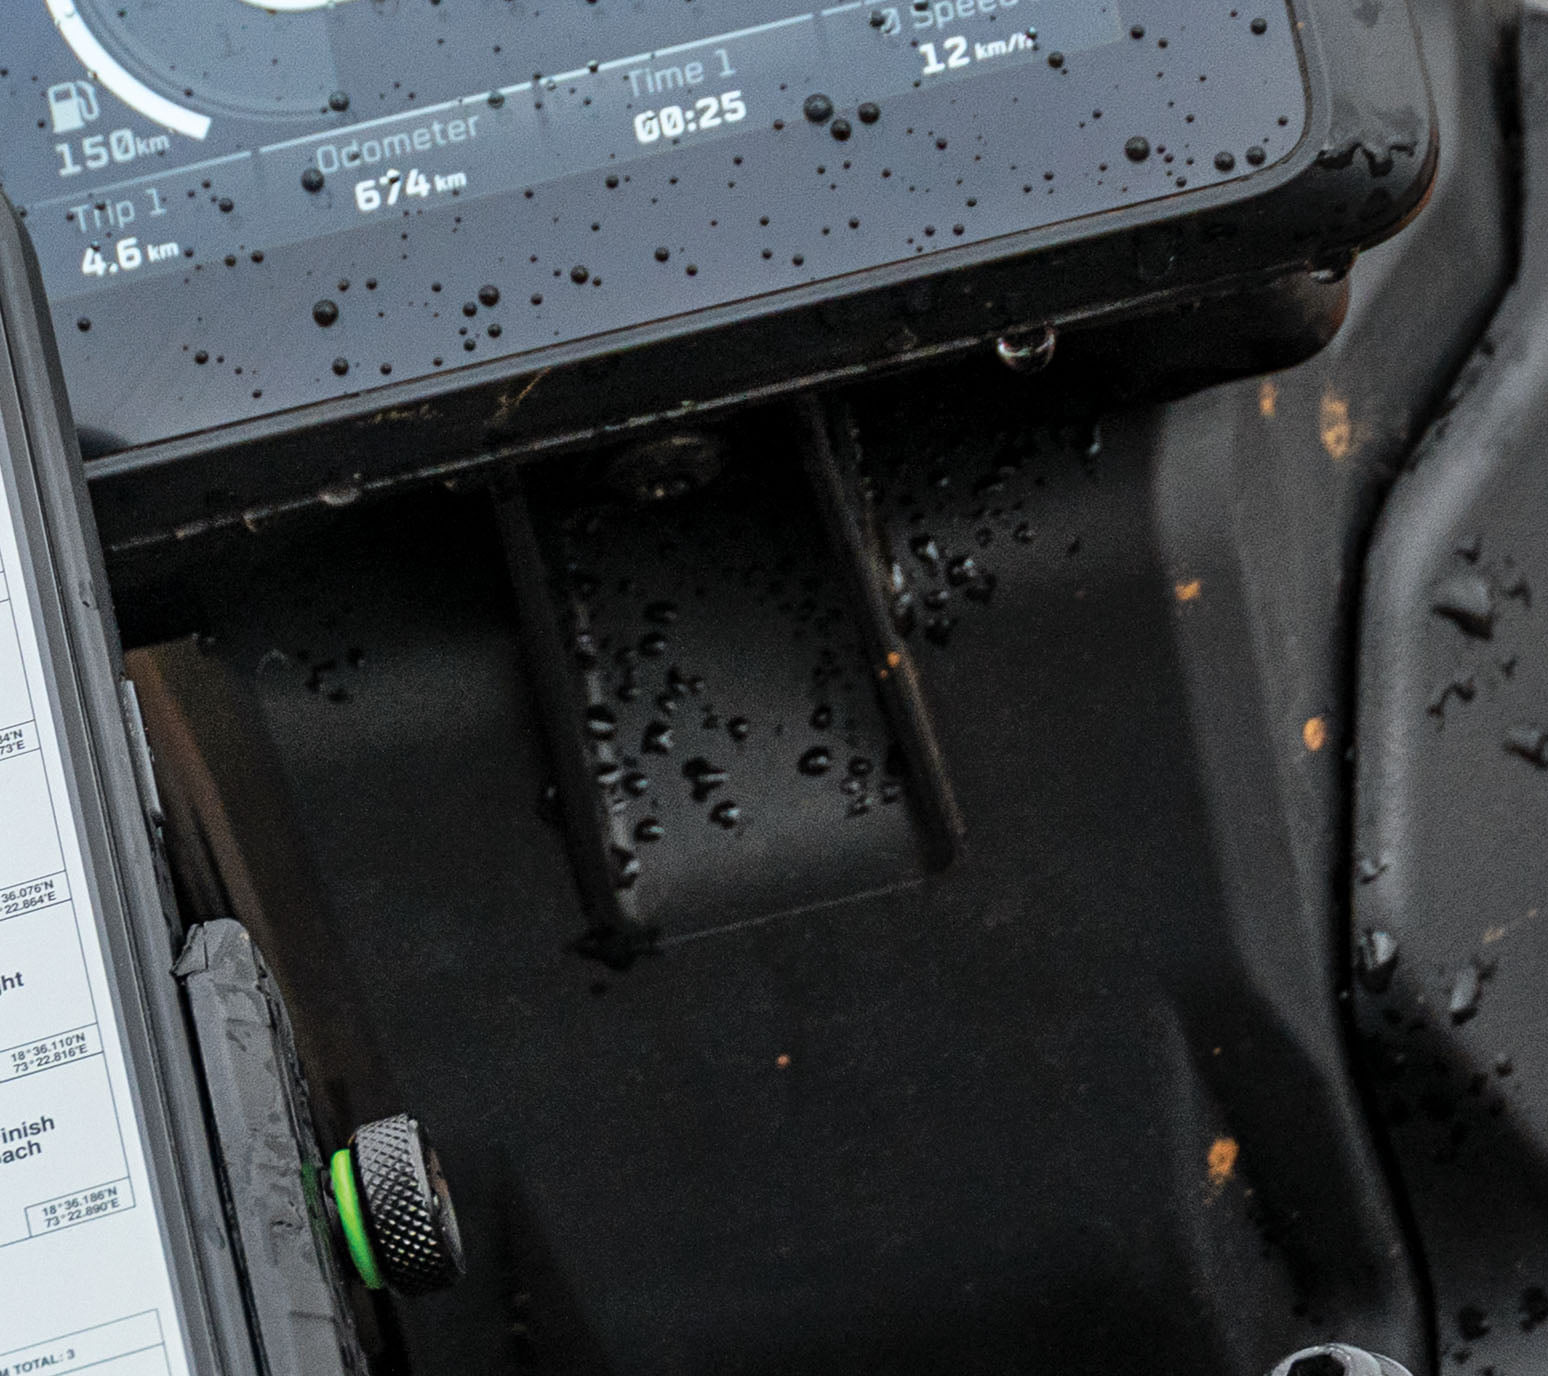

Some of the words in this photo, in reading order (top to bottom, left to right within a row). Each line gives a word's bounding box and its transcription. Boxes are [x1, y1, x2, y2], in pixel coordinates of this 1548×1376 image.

[628, 61, 705, 98] Time
[715, 48, 737, 78] 1
[918, 35, 971, 75] 12
[633, 91, 748, 144] 00:25
[70, 195, 136, 233] Trip
[144, 187, 167, 217] 1
[82, 236, 142, 276] 4.6
[147, 240, 179, 263] km
[66, 1348, 76, 1362] 3
